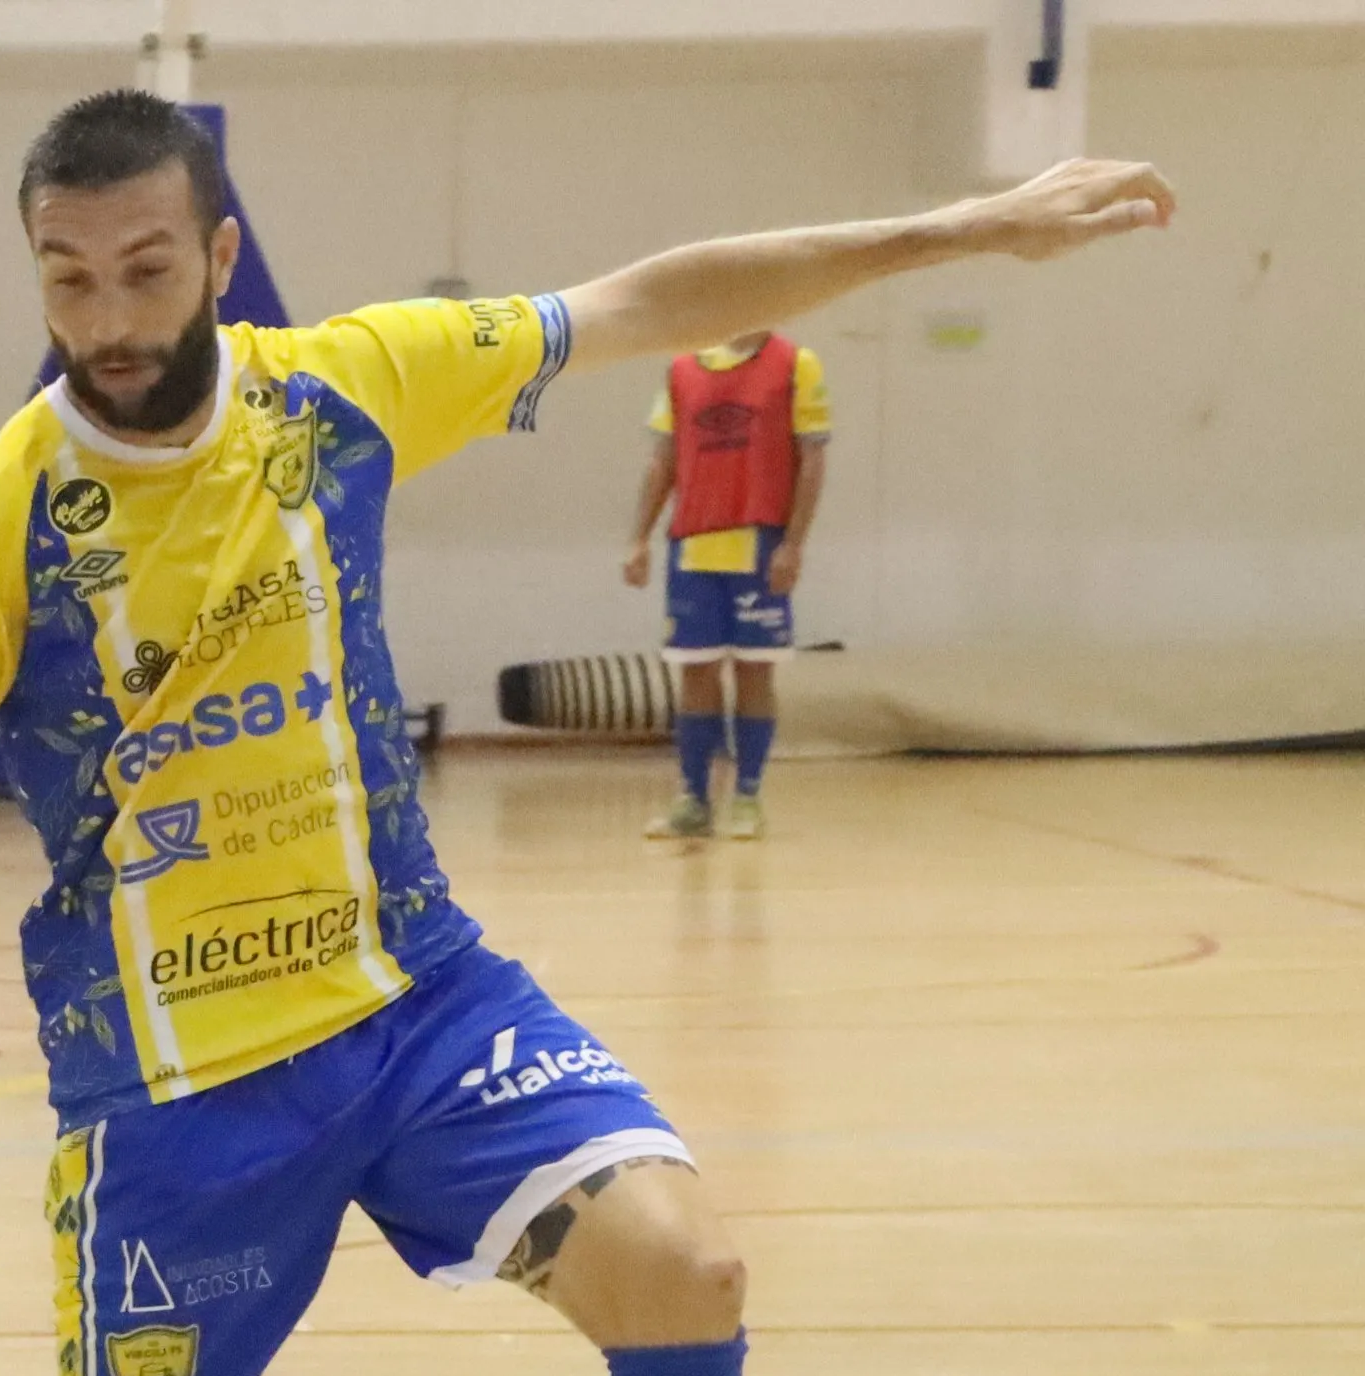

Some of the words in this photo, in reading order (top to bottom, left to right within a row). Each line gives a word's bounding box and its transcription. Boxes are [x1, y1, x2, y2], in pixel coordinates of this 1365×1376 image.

[77, 573, 130, 600] umbro
[223, 831, 257, 857] de
[269, 806, 337, 848] Cádiz
[150, 897, 360, 985] eléctrica
[157, 965, 282, 1006] Comercializadora
[287, 957, 314, 976] de
[185, 1266, 273, 1305] ACOSTA
